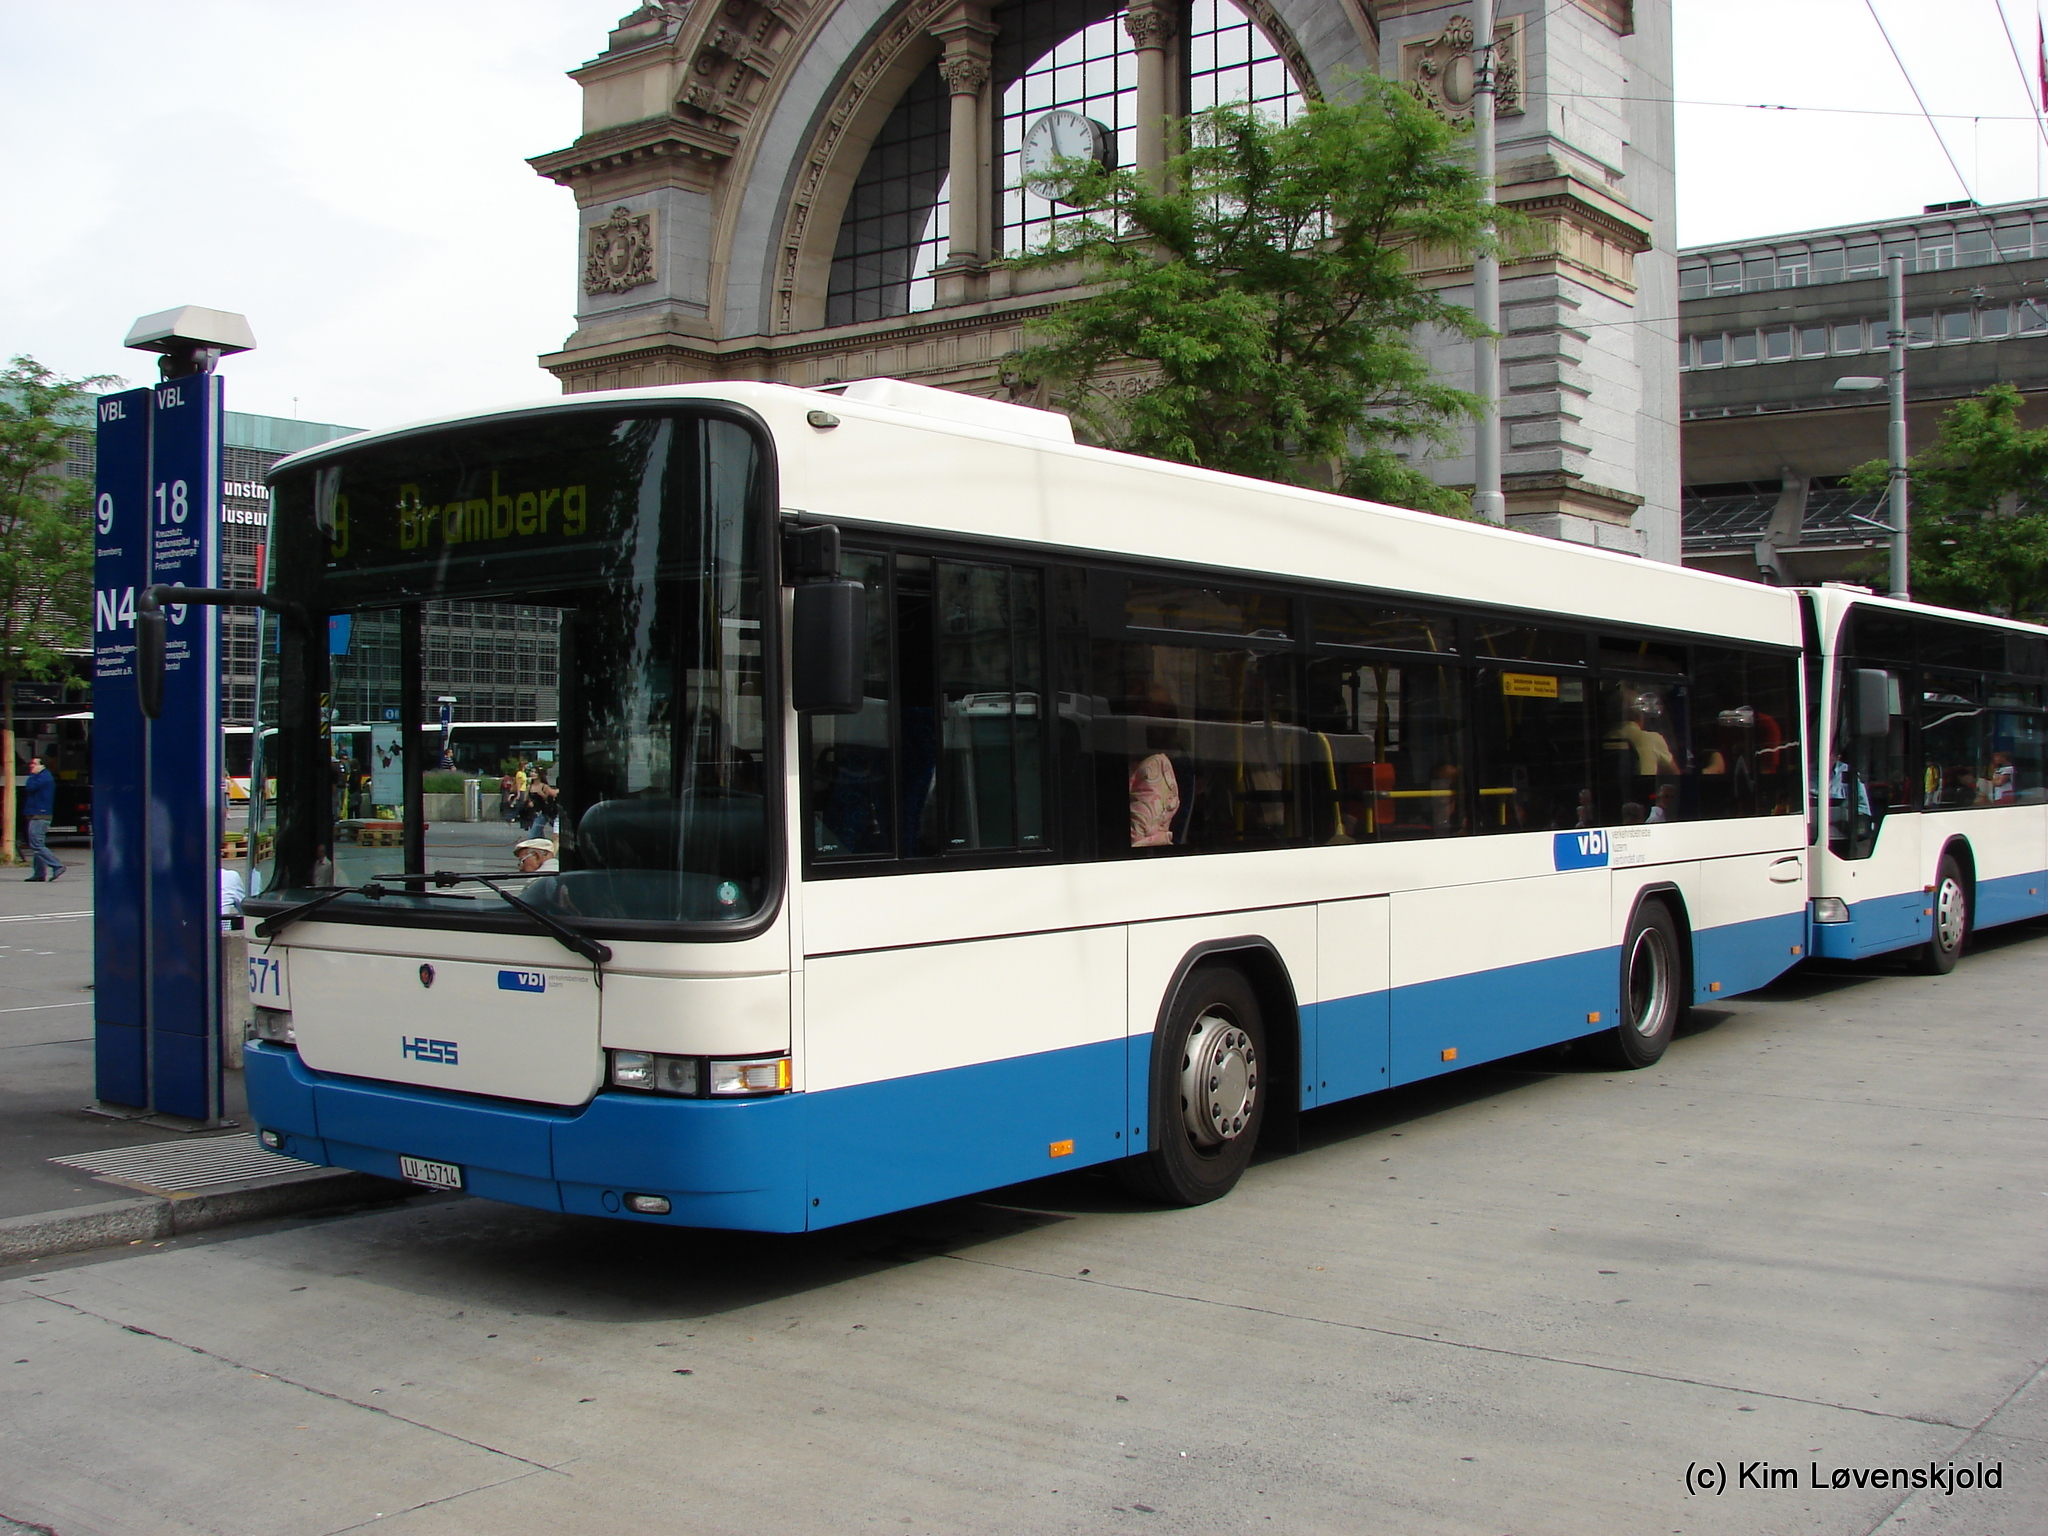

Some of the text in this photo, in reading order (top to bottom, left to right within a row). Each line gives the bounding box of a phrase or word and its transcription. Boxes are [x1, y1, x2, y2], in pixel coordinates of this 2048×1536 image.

[100, 401, 126, 422] VBL
[158, 387, 185, 409] VBL
[155, 480, 188, 525] 18
[223, 481, 269, 499] unstm
[98, 493, 114, 535] 9
[331, 470, 586, 558] 9 Bramberg
[97, 586, 137, 632] N4
[159, 582, 188, 625] 9
[1577, 829, 1607, 856] vbl
[249, 957, 280, 996] 571
[518, 973, 544, 987] vbl
[402, 1035, 458, 1066] HESS
